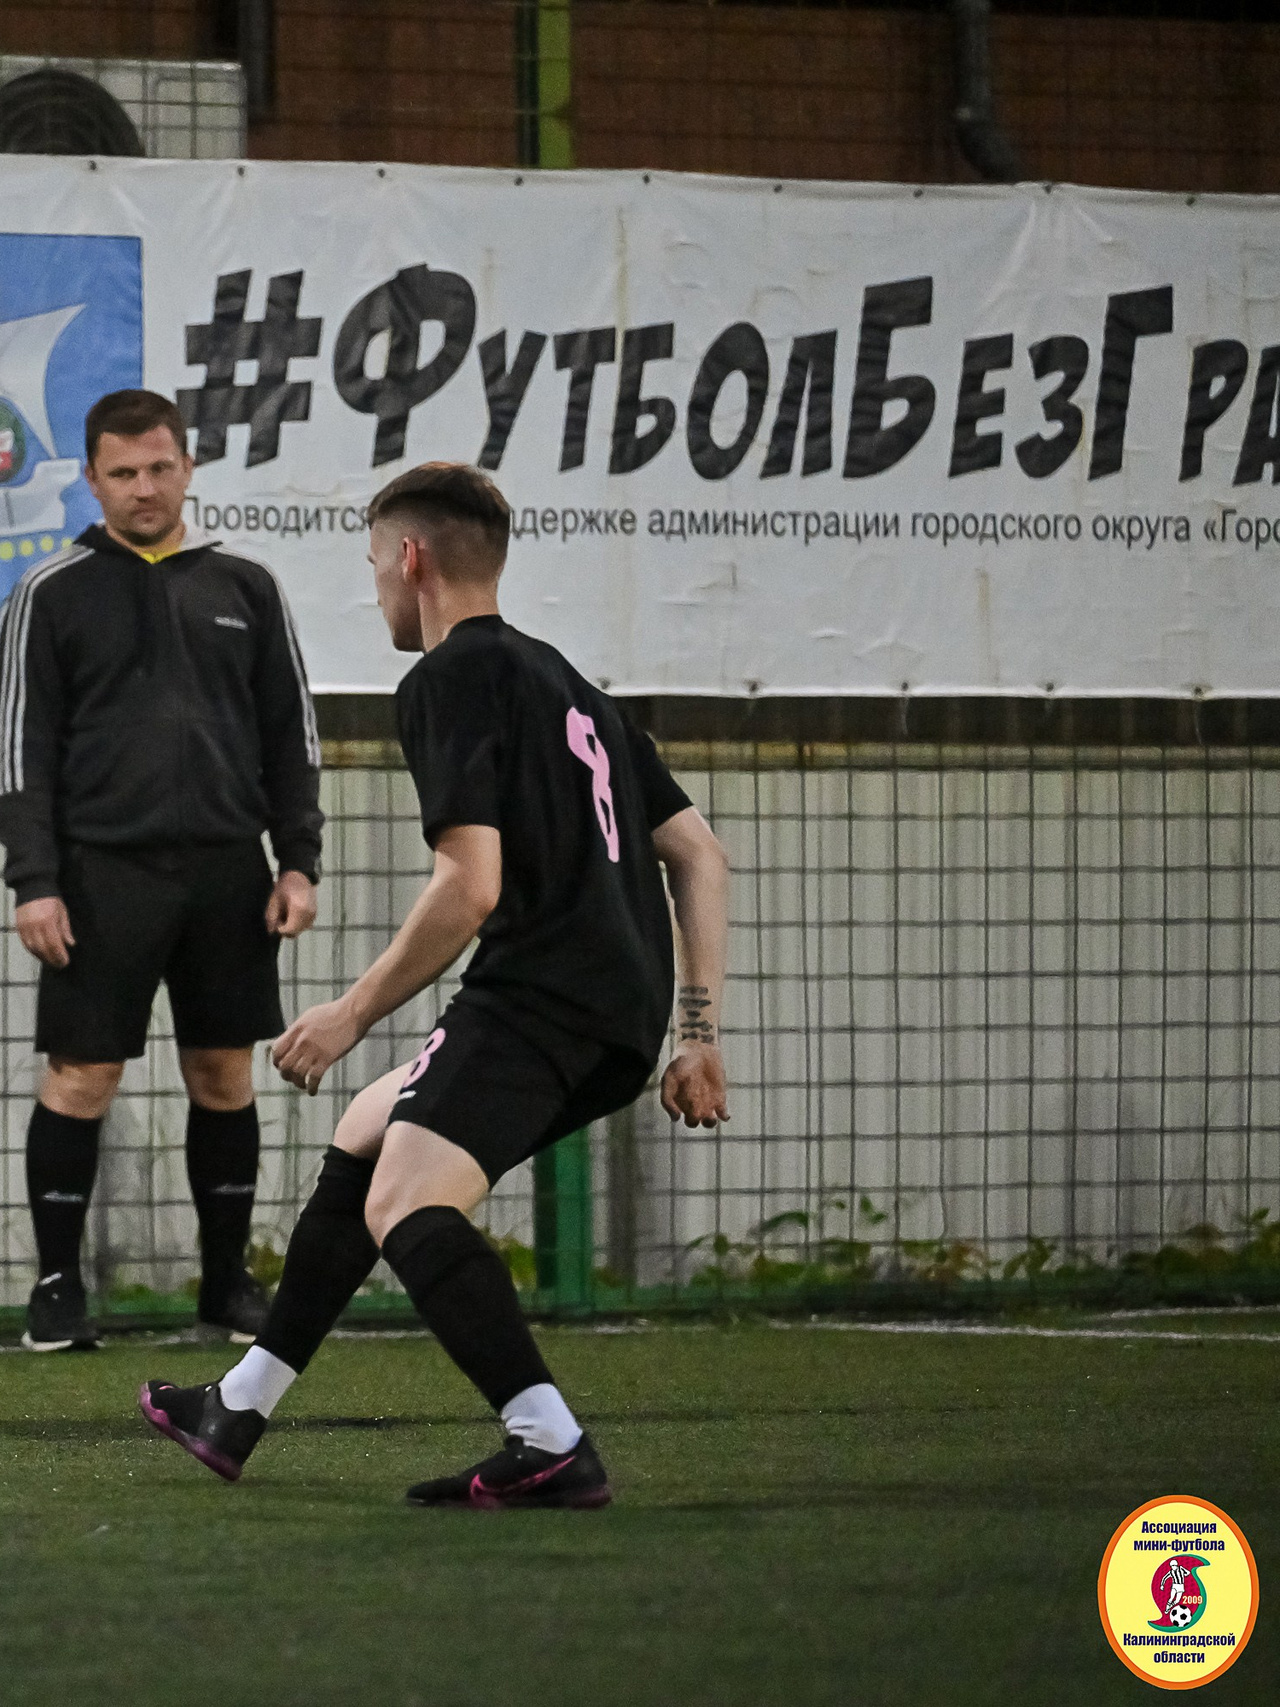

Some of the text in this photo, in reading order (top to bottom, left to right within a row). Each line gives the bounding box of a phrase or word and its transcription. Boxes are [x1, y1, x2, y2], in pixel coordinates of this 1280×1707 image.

[646, 509, 901, 547] администрации
[909, 511, 1082, 549] городского
[1091, 513, 1191, 551] округа
[566, 706, 620, 864] 8
